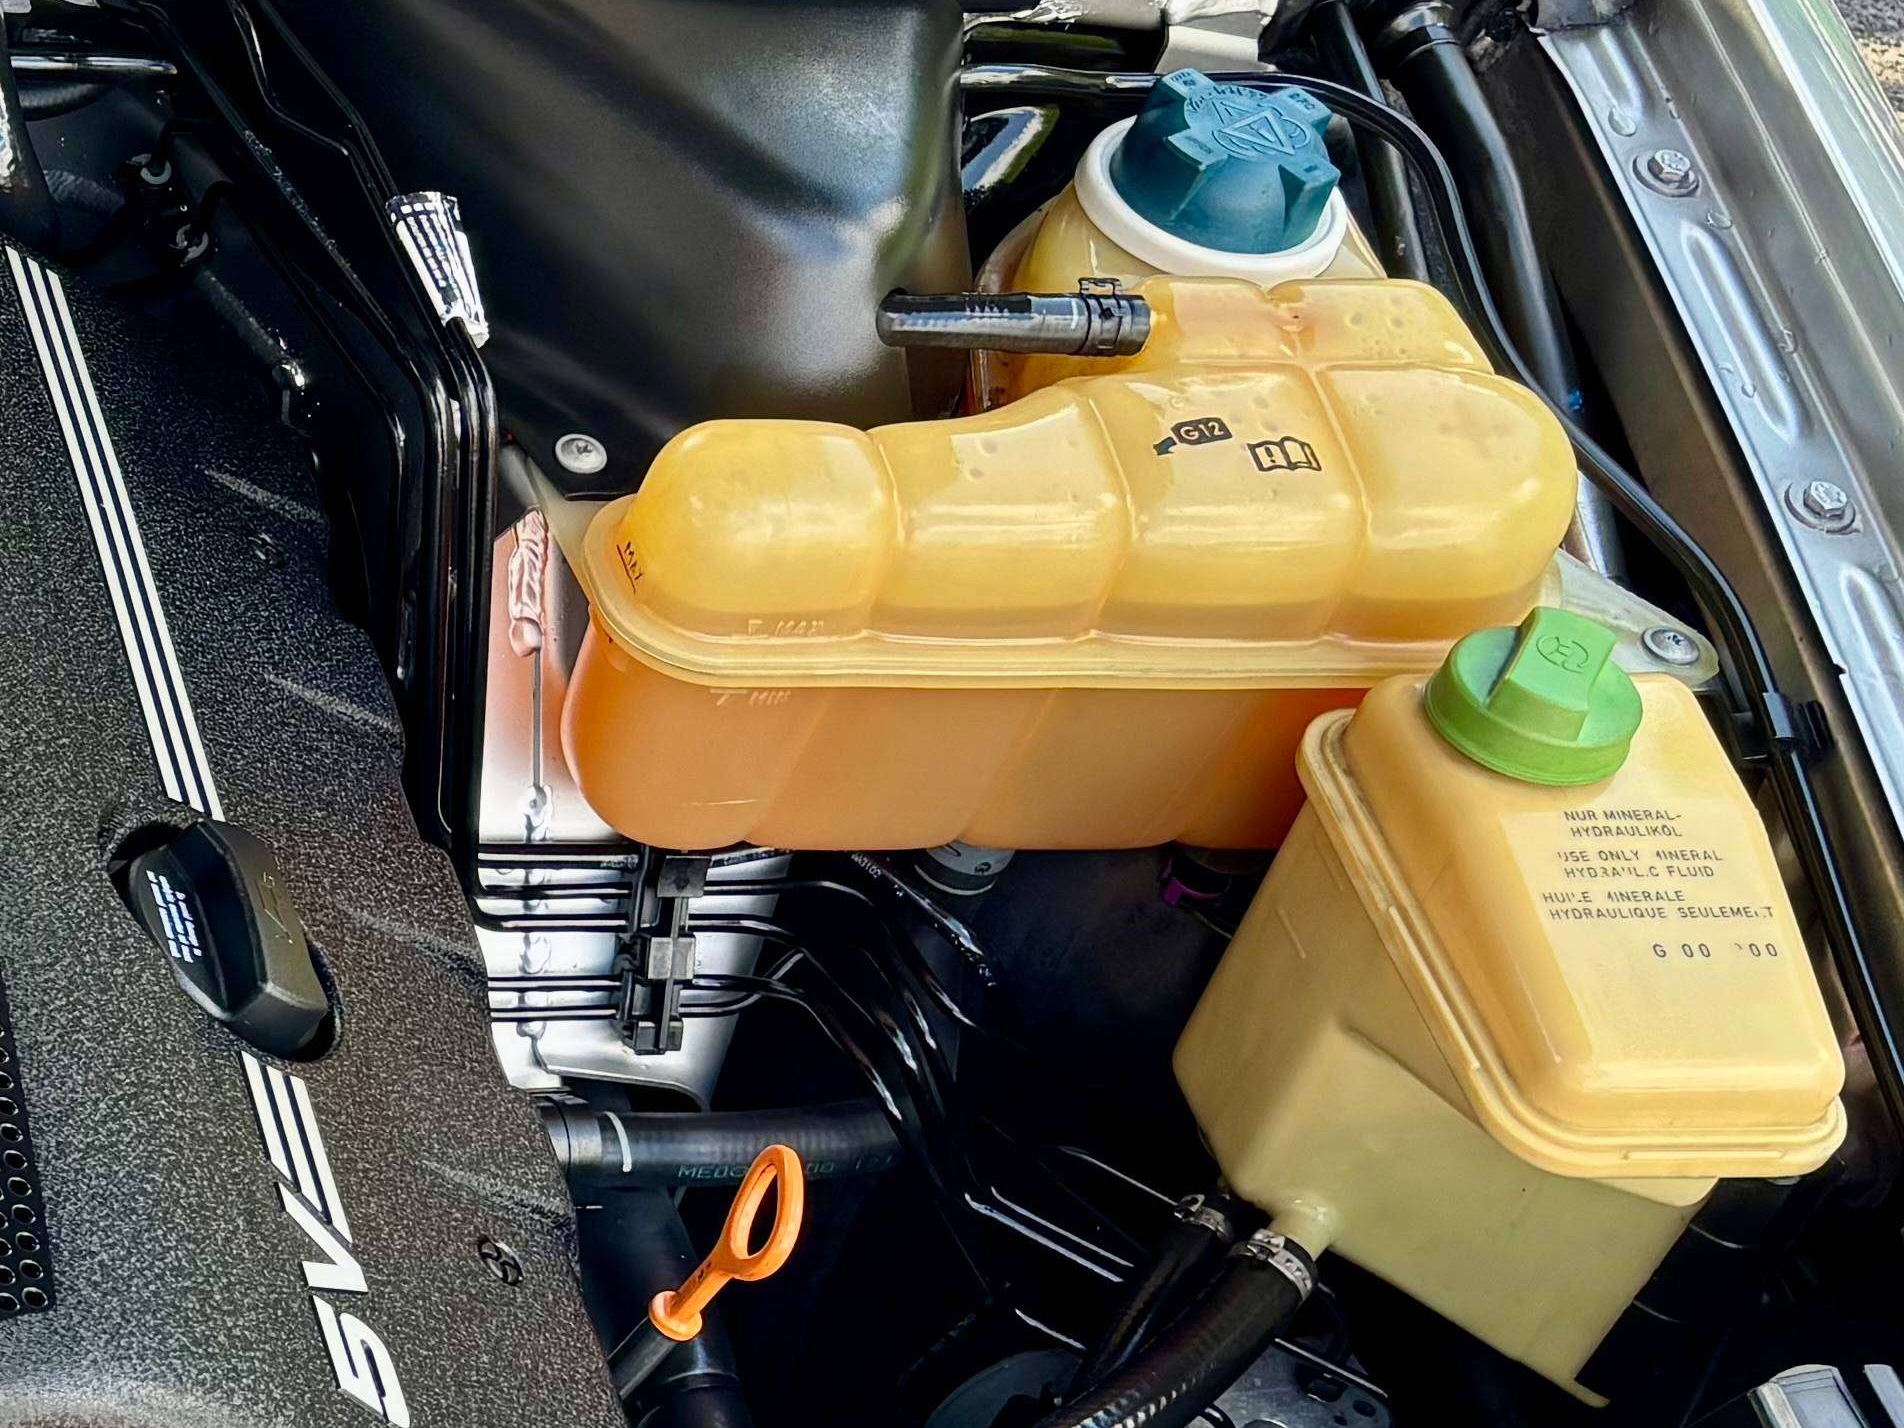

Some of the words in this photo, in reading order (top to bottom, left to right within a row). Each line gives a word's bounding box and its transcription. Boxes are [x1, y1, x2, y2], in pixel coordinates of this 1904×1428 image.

[1179, 421, 1225, 440] G12
[1563, 810, 1598, 822] NUR
[1601, 809, 1683, 822] MINERAL-
[1597, 849, 1641, 862] ONLY
[1667, 865, 1715, 878] FLUID
[1548, 906, 1669, 921] HYDRAULIQUE
[1652, 943, 1667, 959] G
